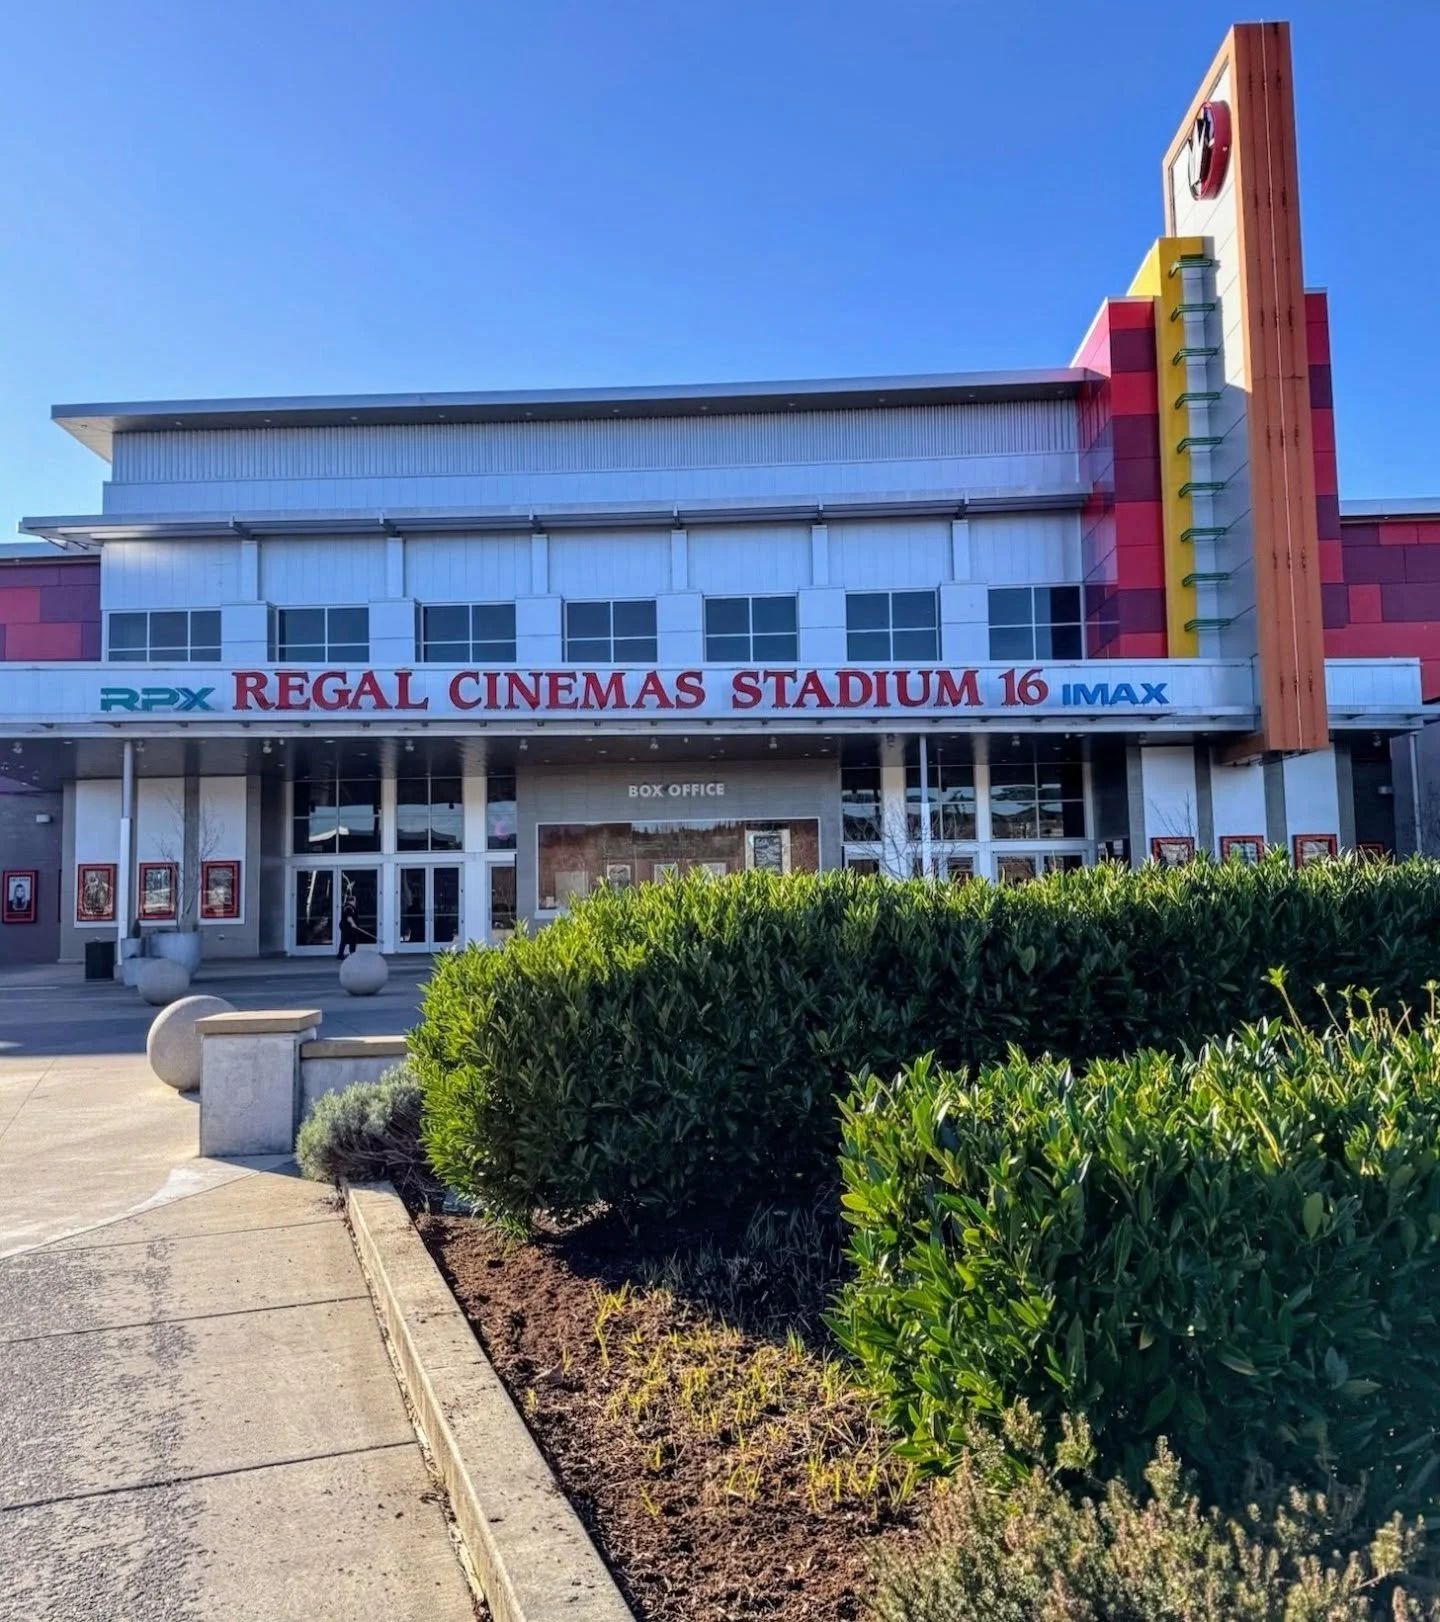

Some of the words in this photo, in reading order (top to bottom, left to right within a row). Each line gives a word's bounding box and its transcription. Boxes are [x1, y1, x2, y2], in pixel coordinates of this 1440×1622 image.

[101, 687, 214, 711] RPX
[232, 671, 429, 711] REGAL
[449, 671, 706, 710] CINEMAS
[731, 669, 983, 709] STADIUM
[999, 668, 1050, 706] 16
[1062, 682, 1170, 706] IMAX
[628, 784, 663, 798] BOX
[668, 783, 725, 797] OFFICE
